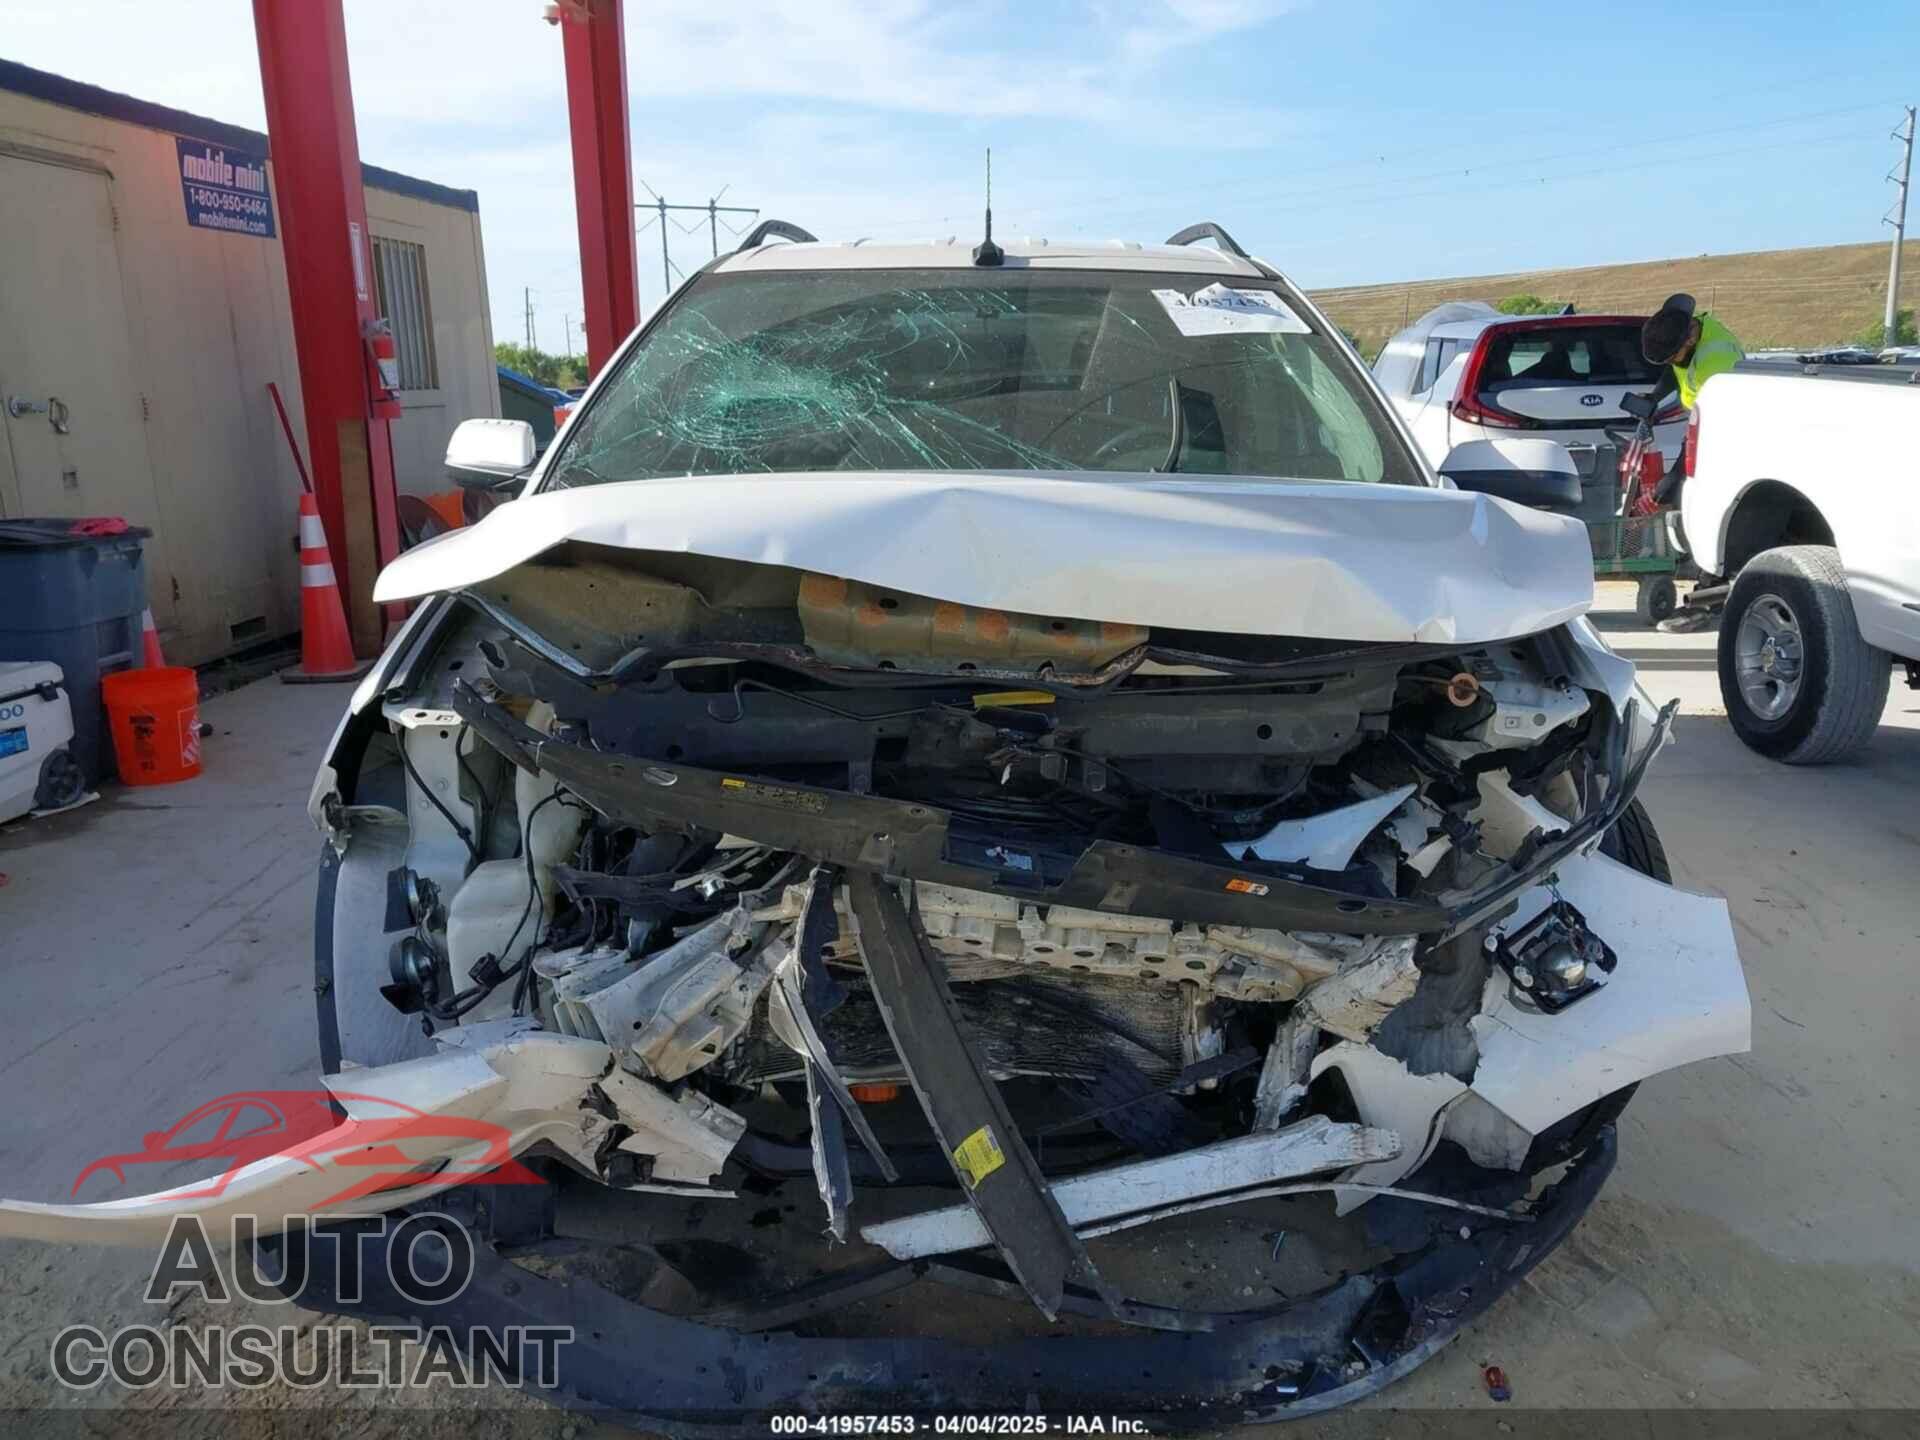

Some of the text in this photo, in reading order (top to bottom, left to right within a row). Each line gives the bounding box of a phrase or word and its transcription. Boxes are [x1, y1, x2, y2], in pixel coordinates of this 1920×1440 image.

[183, 148, 265, 193] mobile mini
[199, 211, 267, 235] mobilemini.com
[1583, 396, 1602, 406] KIA
